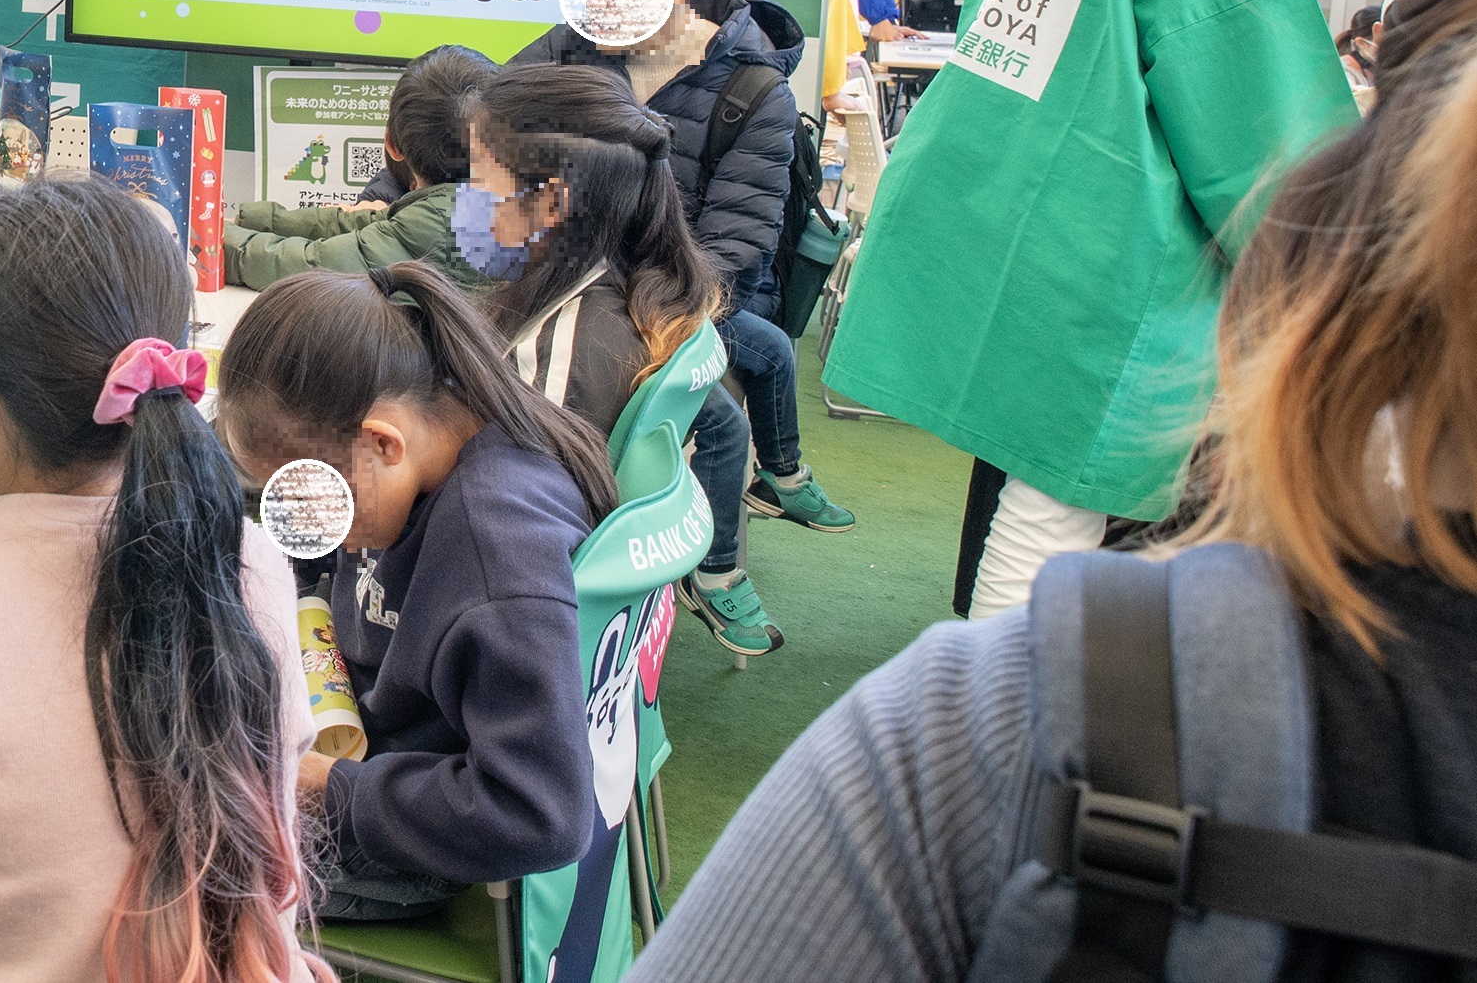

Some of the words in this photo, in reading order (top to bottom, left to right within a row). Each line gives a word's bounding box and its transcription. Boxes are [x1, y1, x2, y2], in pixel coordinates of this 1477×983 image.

[982, 7, 1037, 47] OYA
[123, 154, 154, 164] MERRY
[299, 191, 360, 202] アンケートにご
[688, 348, 724, 393] BANK
[628, 522, 693, 571] BANK
[682, 508, 706, 546] OF
